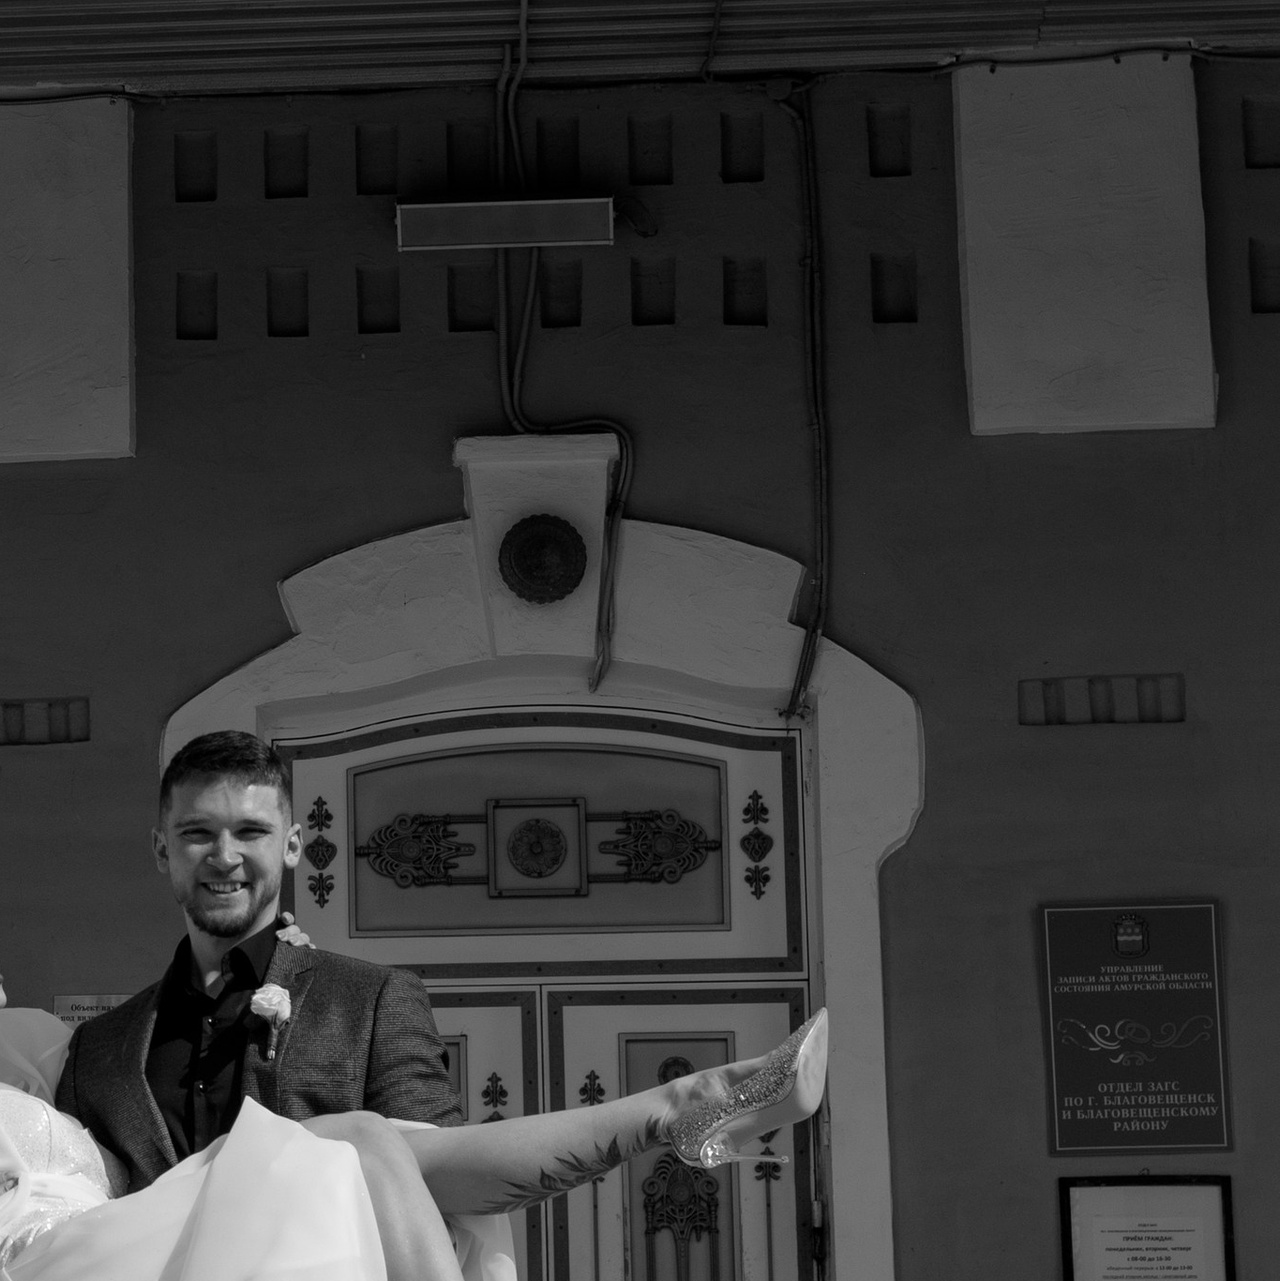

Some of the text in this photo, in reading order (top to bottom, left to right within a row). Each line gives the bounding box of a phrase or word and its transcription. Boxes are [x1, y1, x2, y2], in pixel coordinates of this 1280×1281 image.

[1100, 964, 1164, 973] УПРАВЛЕНИЕ
[1057, 972, 1208, 984] ЗАПИСИ АКТОВ ГРАЖДАНСКОГО
[1054, 981, 1213, 993] СОСТОЯНИЯ АМУРСКОЙ ОБЛАСТИ
[1097, 1081, 1180, 1094] ОТДЕЛ ЗАГС
[1064, 1093, 1216, 1107] ПО Г. БЛАГОВЕЩЕНСК
[1062, 1106, 1219, 1120] И БЛАГОВЕЩЕНСКОМУ
[1113, 1119, 1169, 1132] РАЙОНУ
